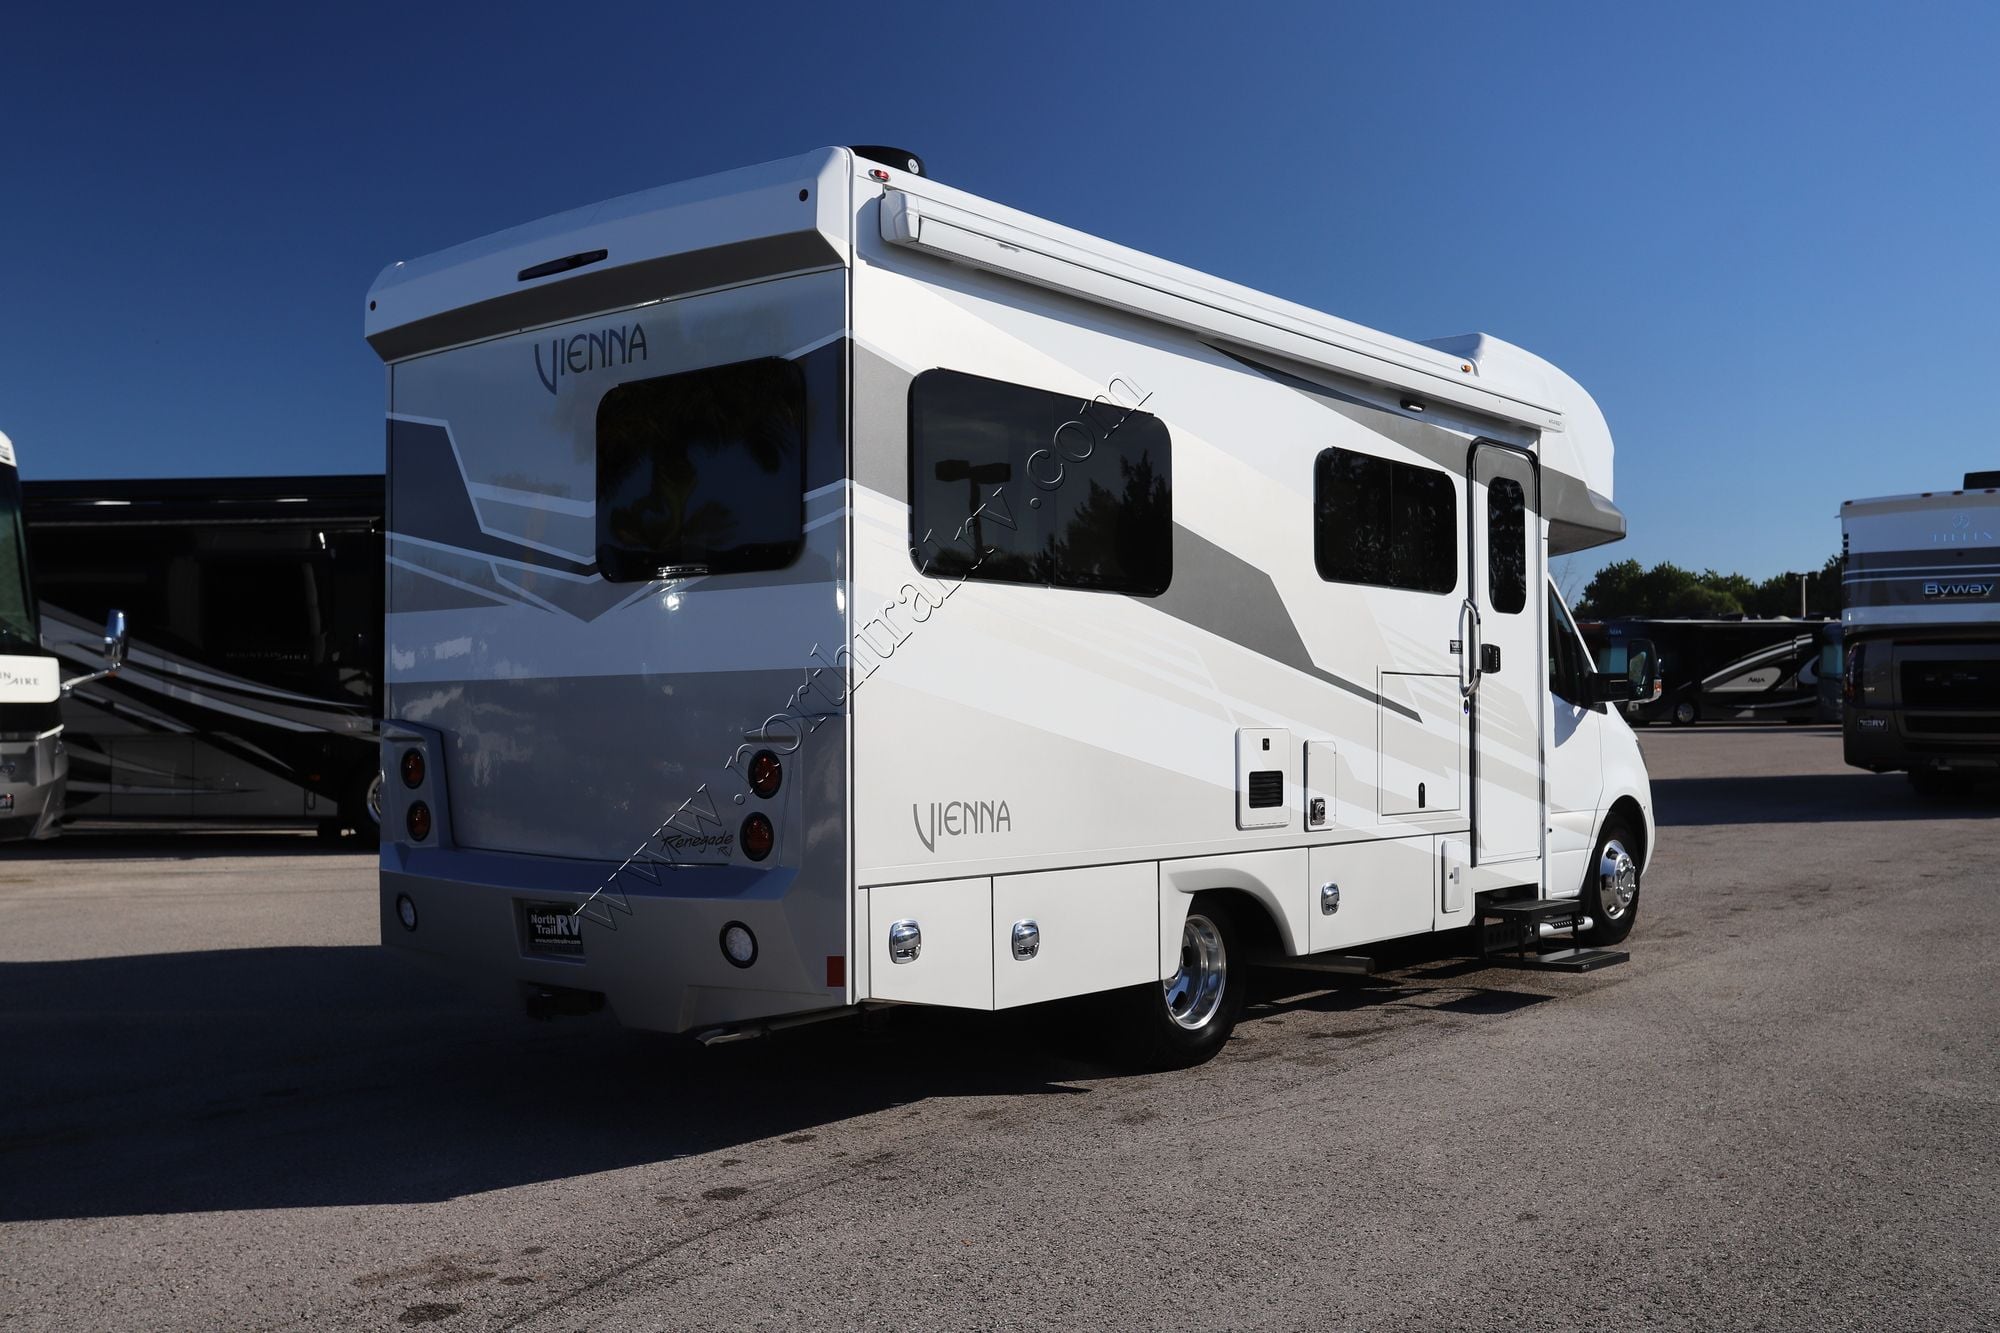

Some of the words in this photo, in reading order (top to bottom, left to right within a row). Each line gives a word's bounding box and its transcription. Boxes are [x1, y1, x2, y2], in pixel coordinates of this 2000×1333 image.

[534, 323, 647, 395] VIENNA
[1924, 584, 1994, 597] Byway
[913, 800, 1011, 853] VIENNA
[660, 830, 734, 854] Renegade
[530, 914, 556, 925] North
[535, 924, 557, 935] Trail
[555, 914, 581, 936] RV
